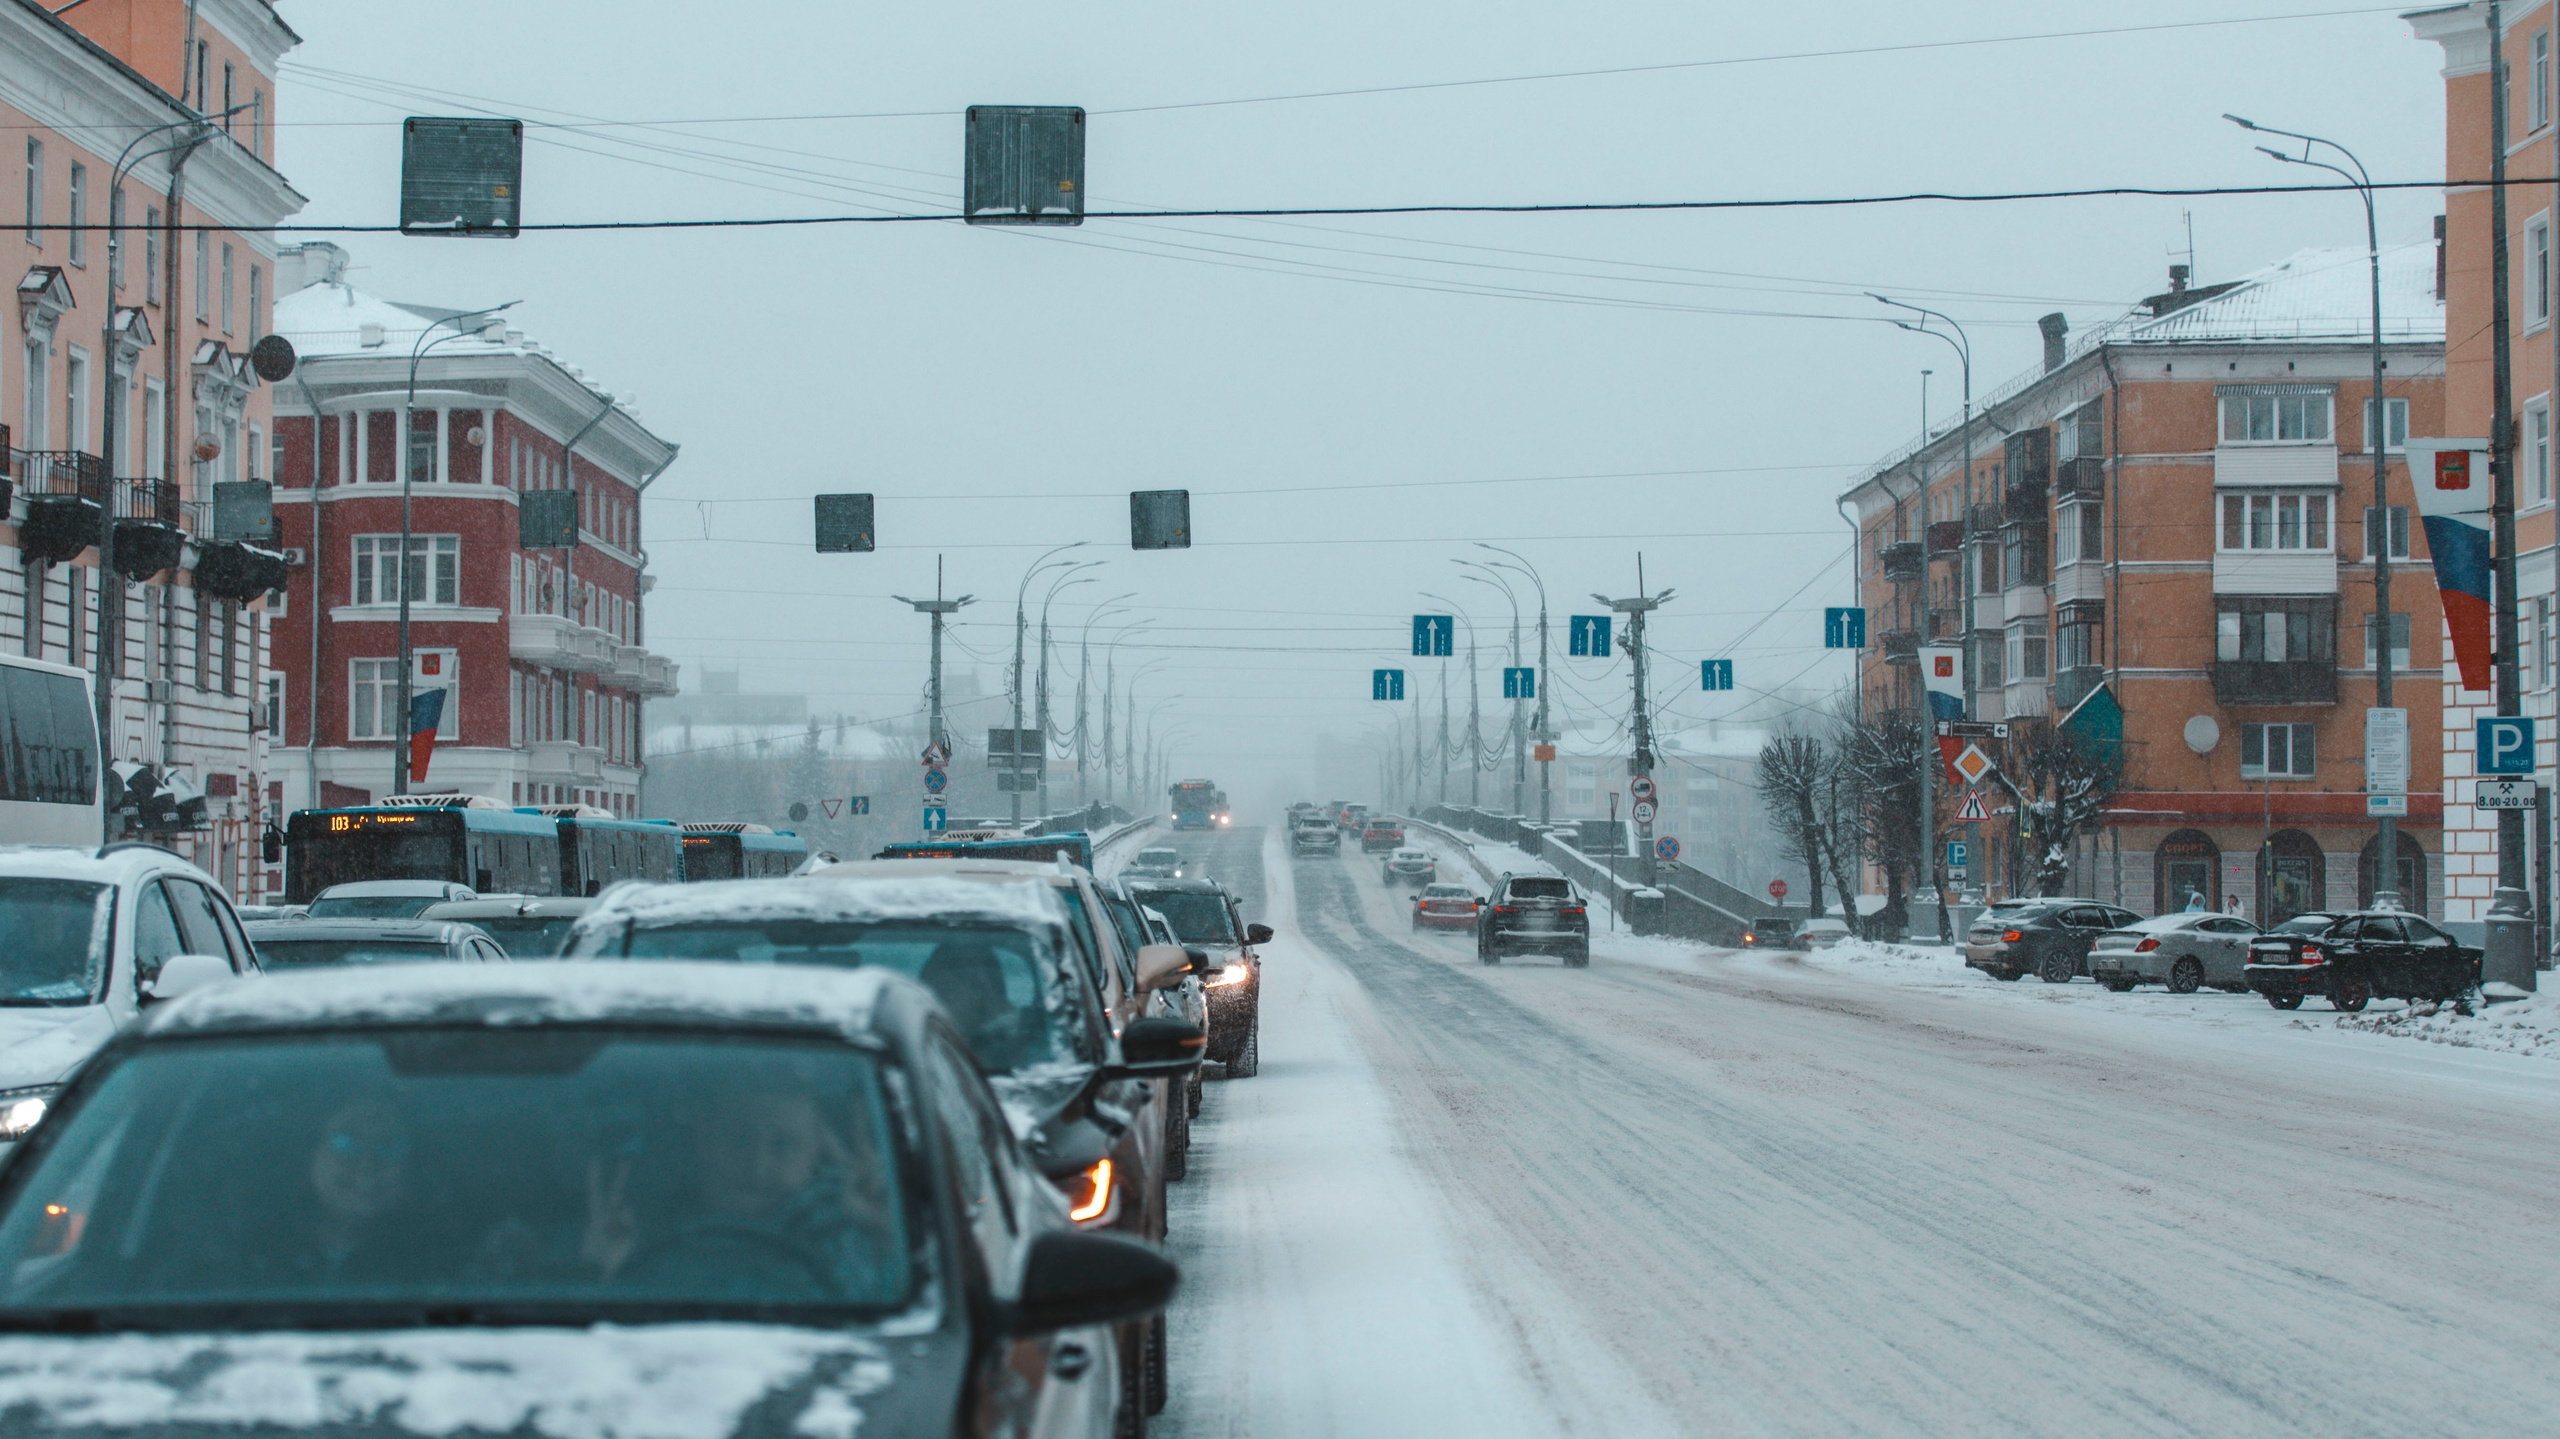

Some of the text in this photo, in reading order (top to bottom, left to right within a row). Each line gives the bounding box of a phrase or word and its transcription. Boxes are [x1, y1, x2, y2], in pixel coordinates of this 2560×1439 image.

[2492, 724, 2522, 768] P
[331, 816, 349, 831] 103
[1954, 845, 1966, 863] P
[2165, 843, 2206, 854] СПОРТ
